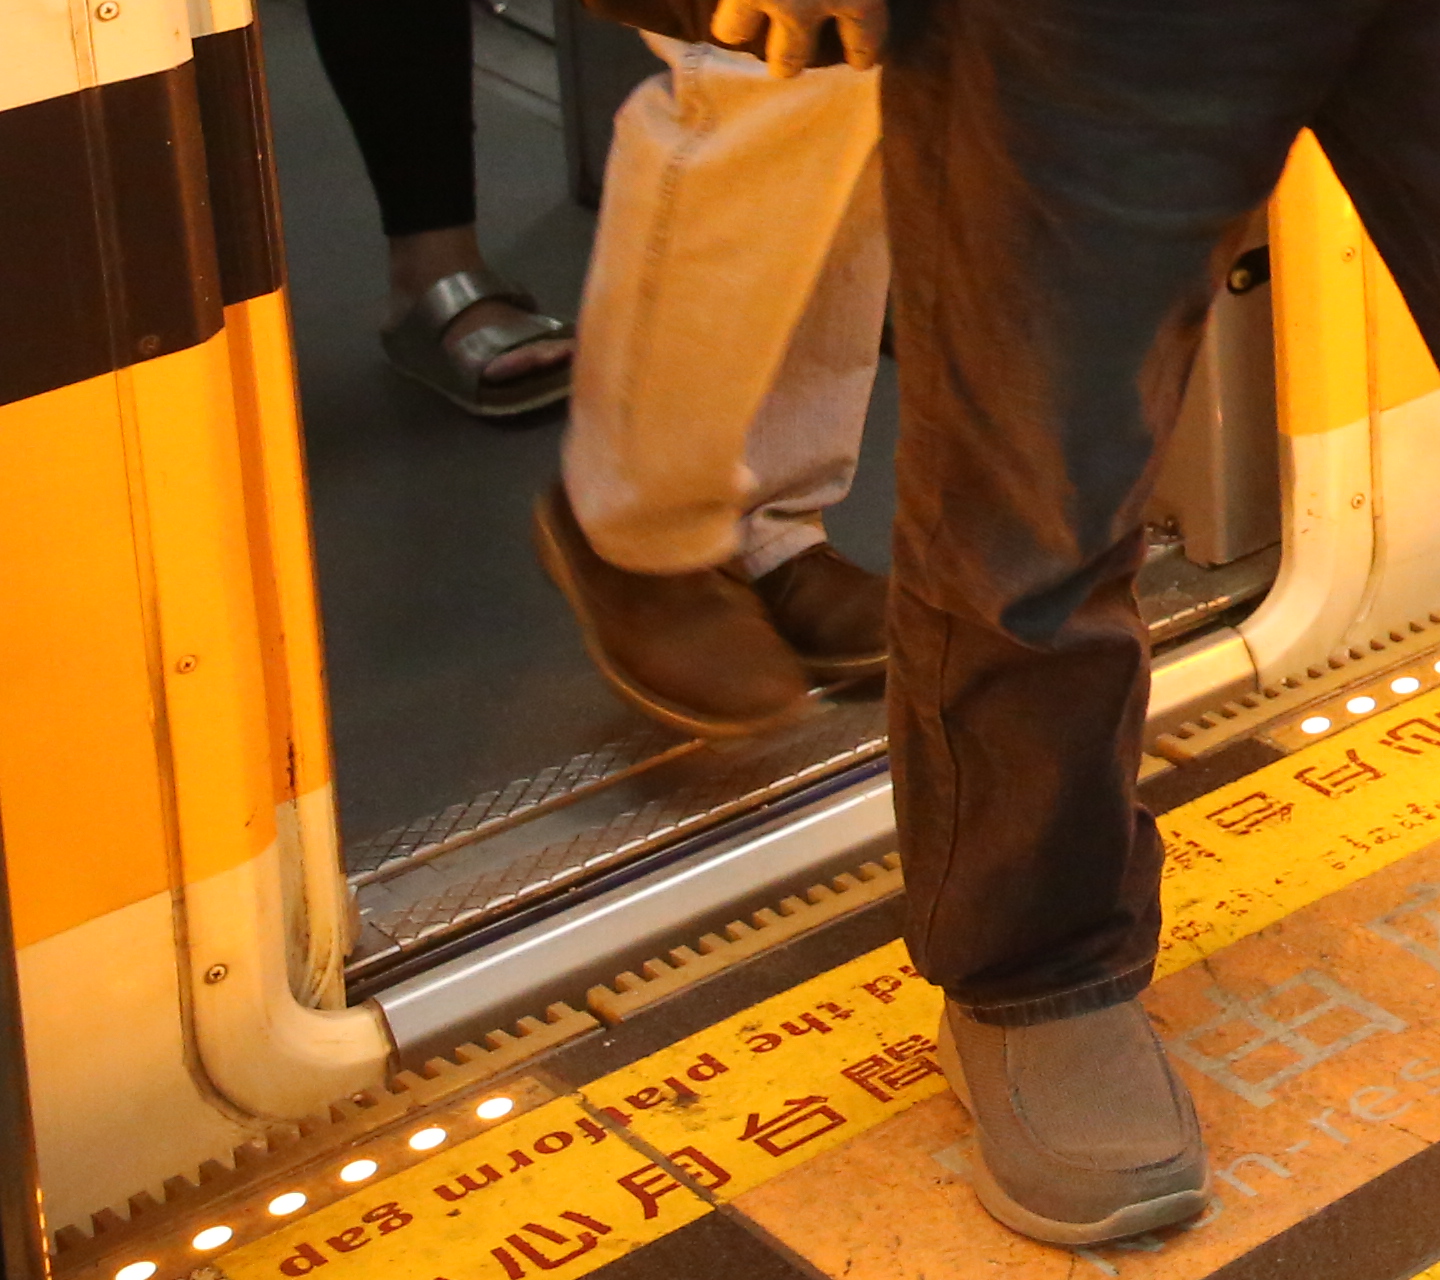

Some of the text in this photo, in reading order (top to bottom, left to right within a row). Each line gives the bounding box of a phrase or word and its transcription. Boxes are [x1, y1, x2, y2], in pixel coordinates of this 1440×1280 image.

[277, 1001, 856, 1278] the platform gap
